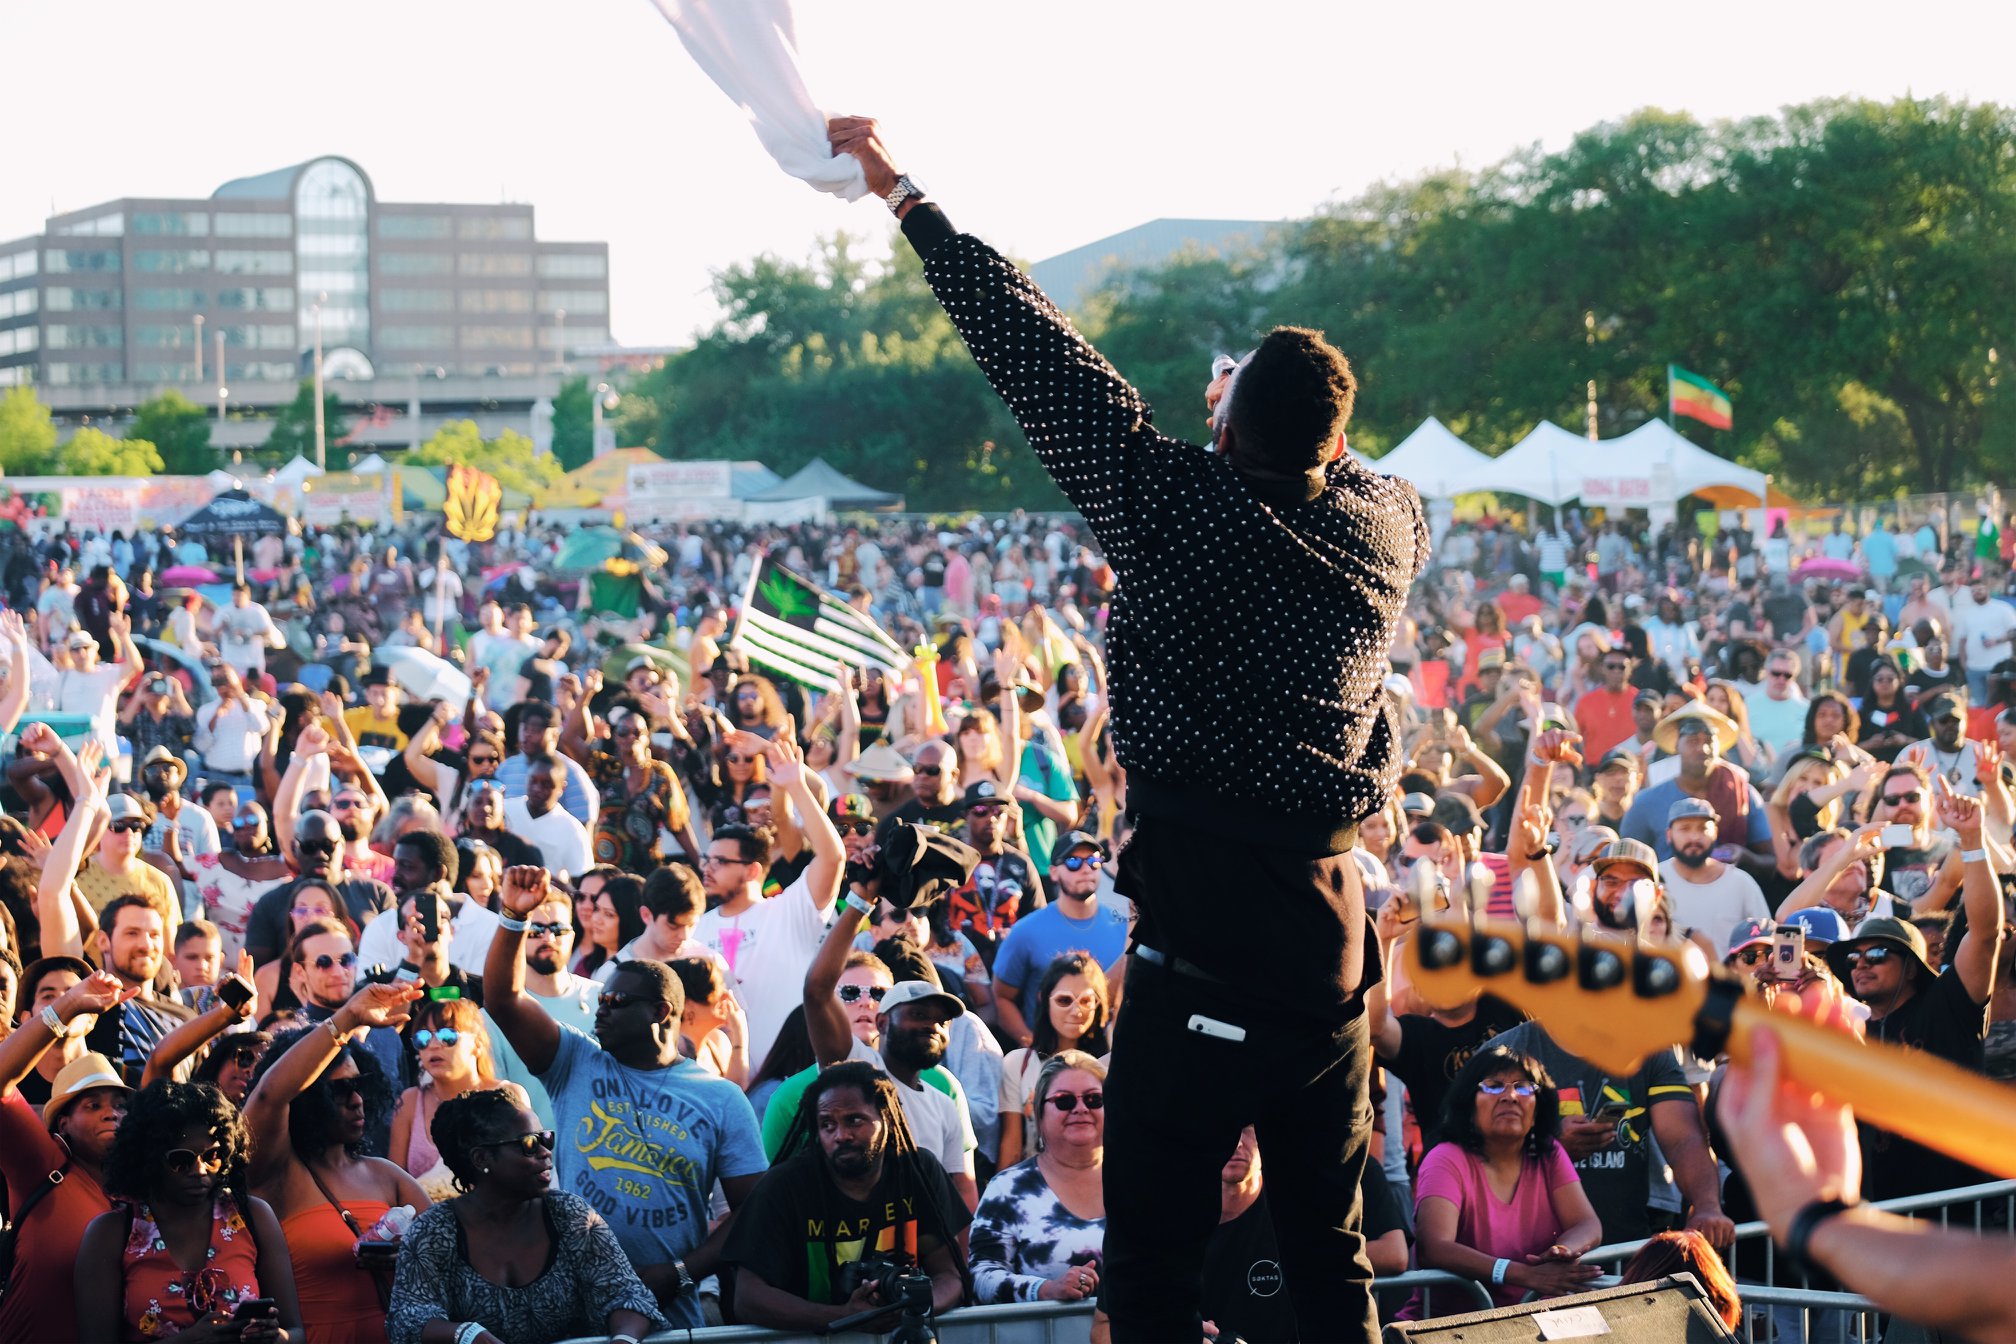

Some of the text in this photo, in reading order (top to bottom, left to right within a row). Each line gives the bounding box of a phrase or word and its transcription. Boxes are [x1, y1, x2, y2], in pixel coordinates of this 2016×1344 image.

[591, 1078, 710, 1140] ON LOVE
[607, 1101, 689, 1142] ESTISHED
[575, 1100, 700, 1179] Jamaica
[576, 1170, 689, 1229] GOOD VIBES
[615, 1177, 652, 1199] 1962
[807, 1197, 914, 1238] MAREY
